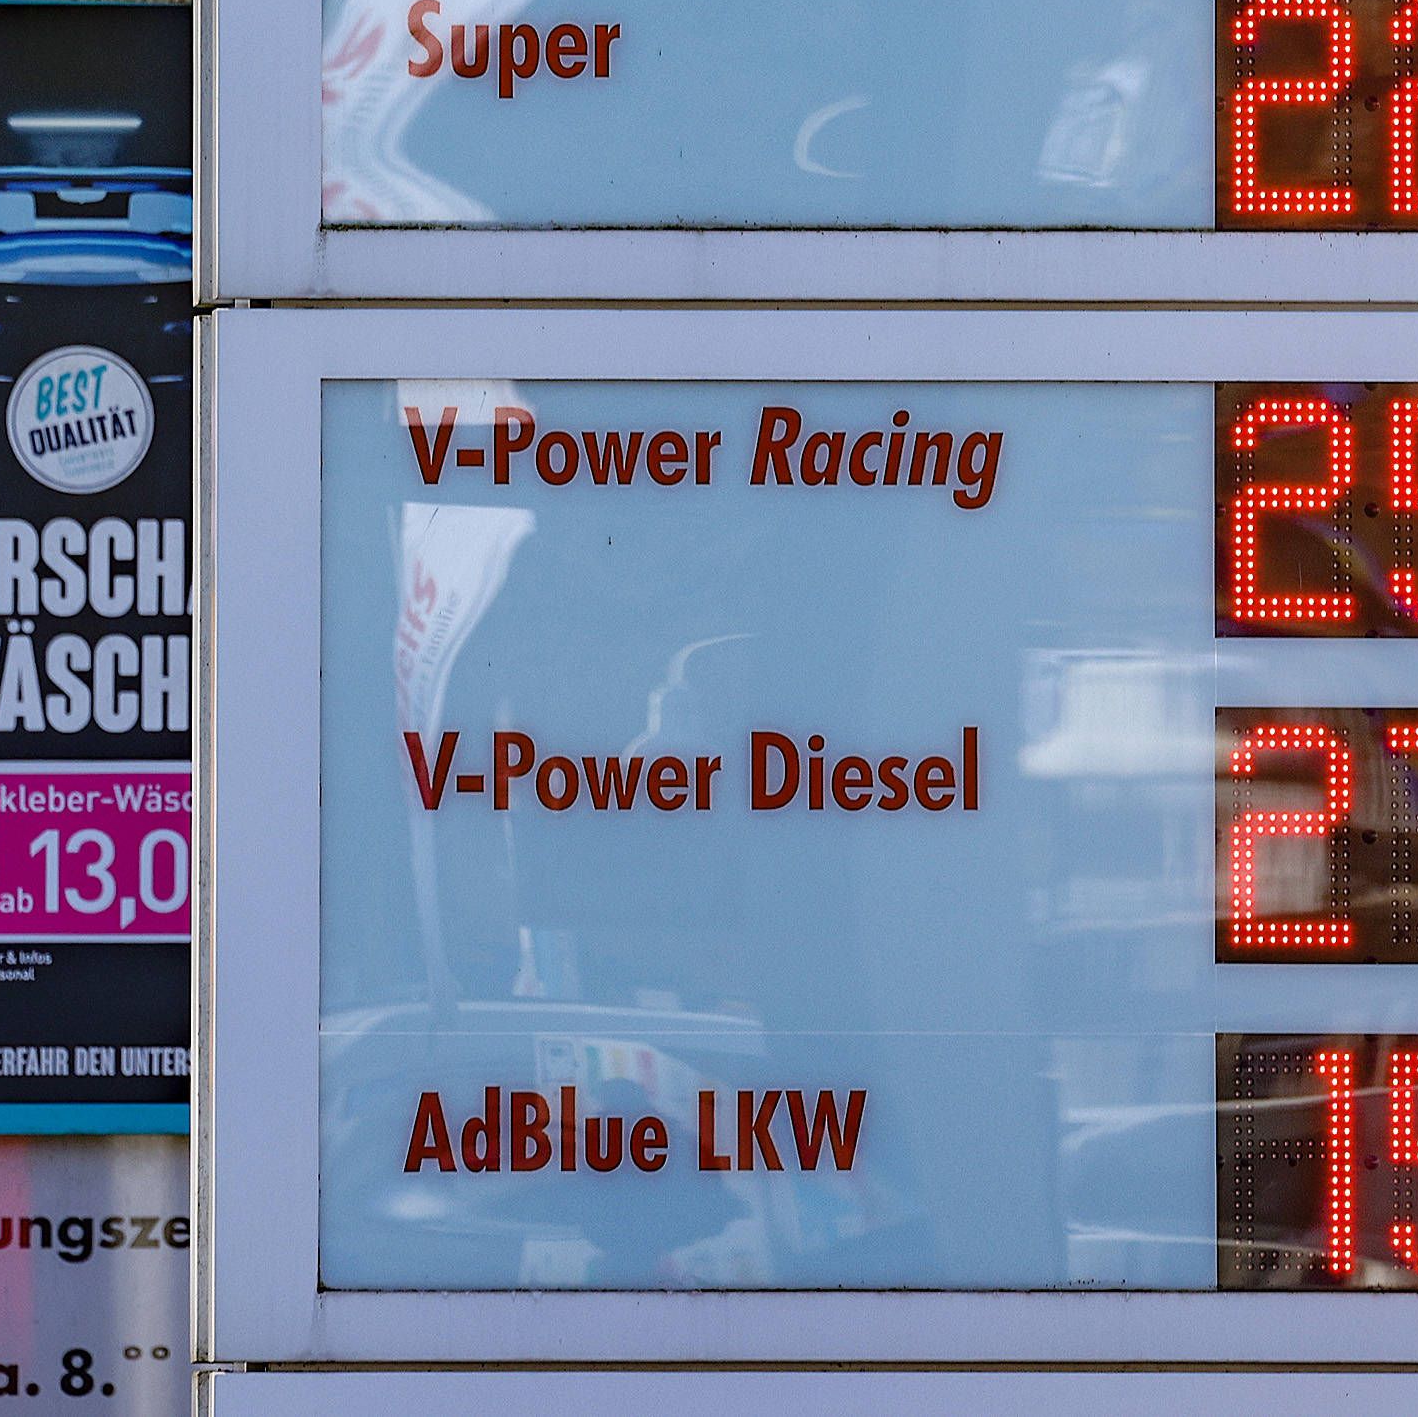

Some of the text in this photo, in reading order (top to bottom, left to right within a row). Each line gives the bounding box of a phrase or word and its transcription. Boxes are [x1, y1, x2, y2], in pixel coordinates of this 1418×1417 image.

[35, 364, 107, 421] BEST
[28, 405, 137, 457] QUALITÄT
[404, 406, 1004, 510] V-Power Racing
[403, 726, 980, 812] V-Power Diesel
[6, 950, 17, 965] &
[74, 1046, 116, 1077] DEN
[402, 1086, 869, 1173] AdBlue LKW
